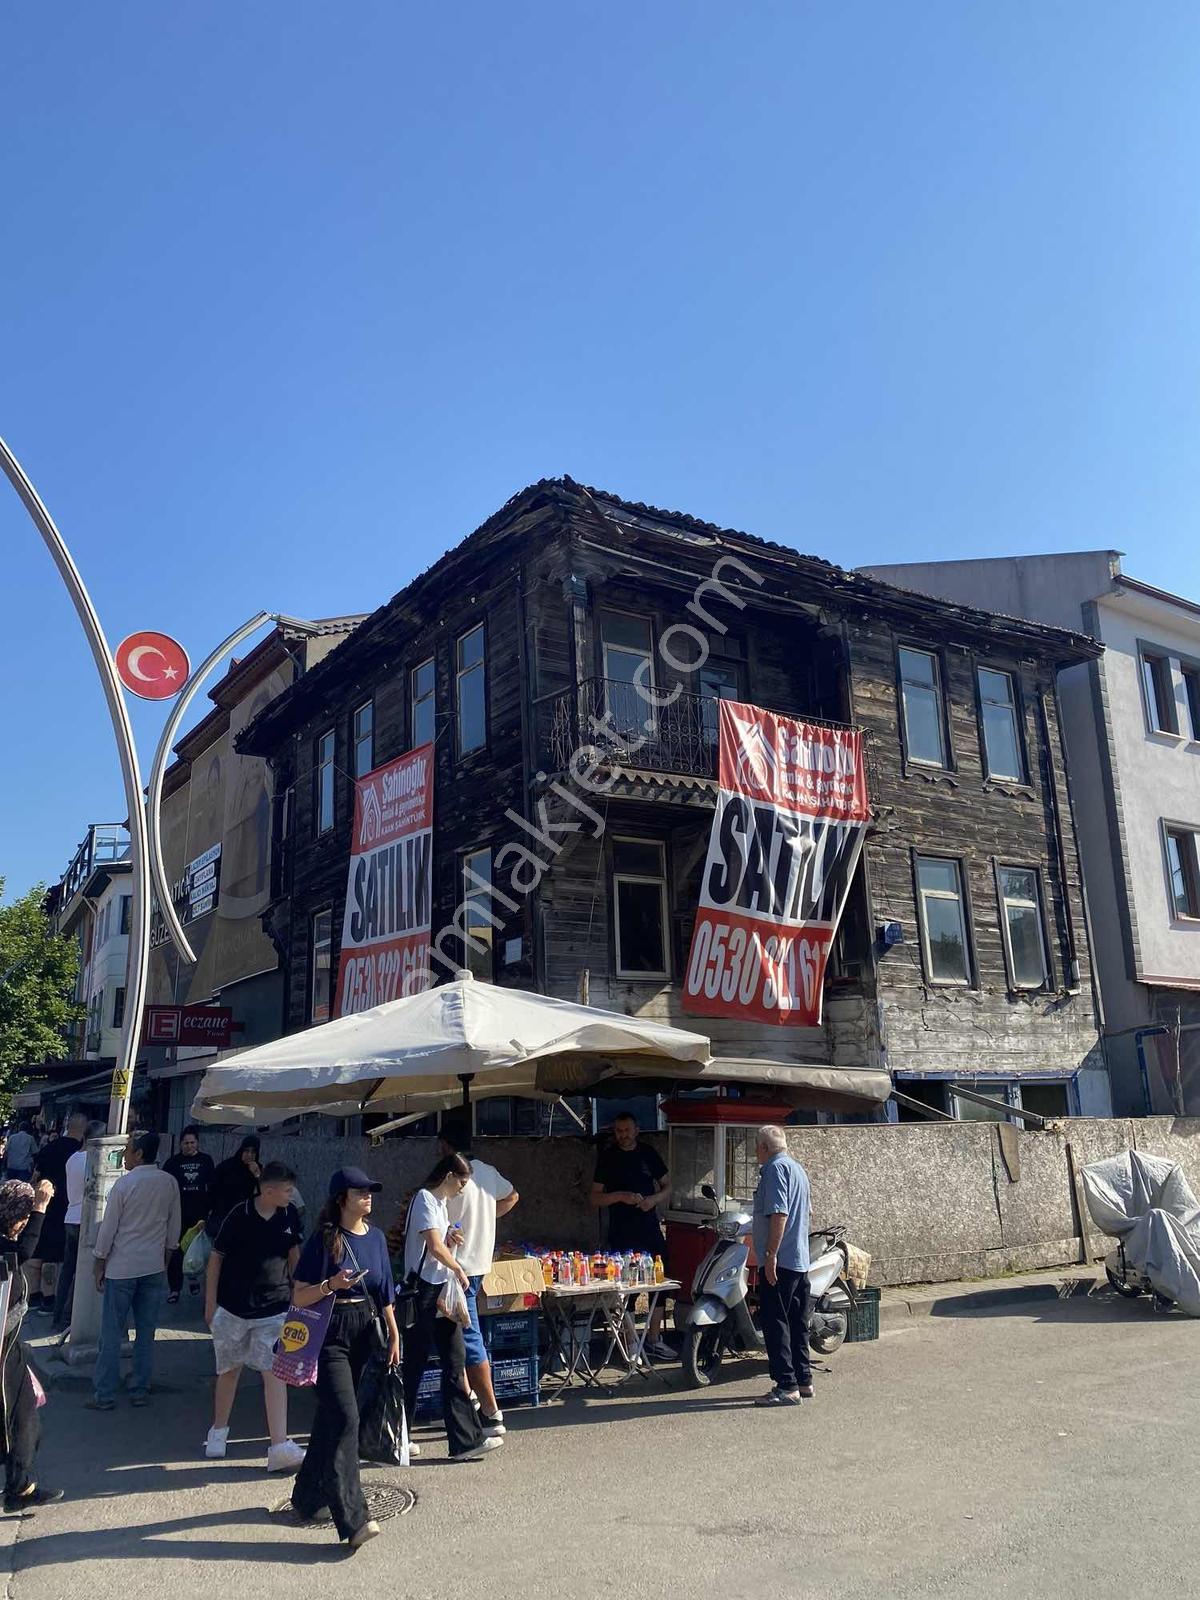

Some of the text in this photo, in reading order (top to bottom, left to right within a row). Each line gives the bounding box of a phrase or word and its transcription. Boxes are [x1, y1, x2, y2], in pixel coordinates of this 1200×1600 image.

[351, 833, 431, 943] SATILIK
[688, 920, 762, 1006] 0530
[183, 1016, 229, 1029] eczane
